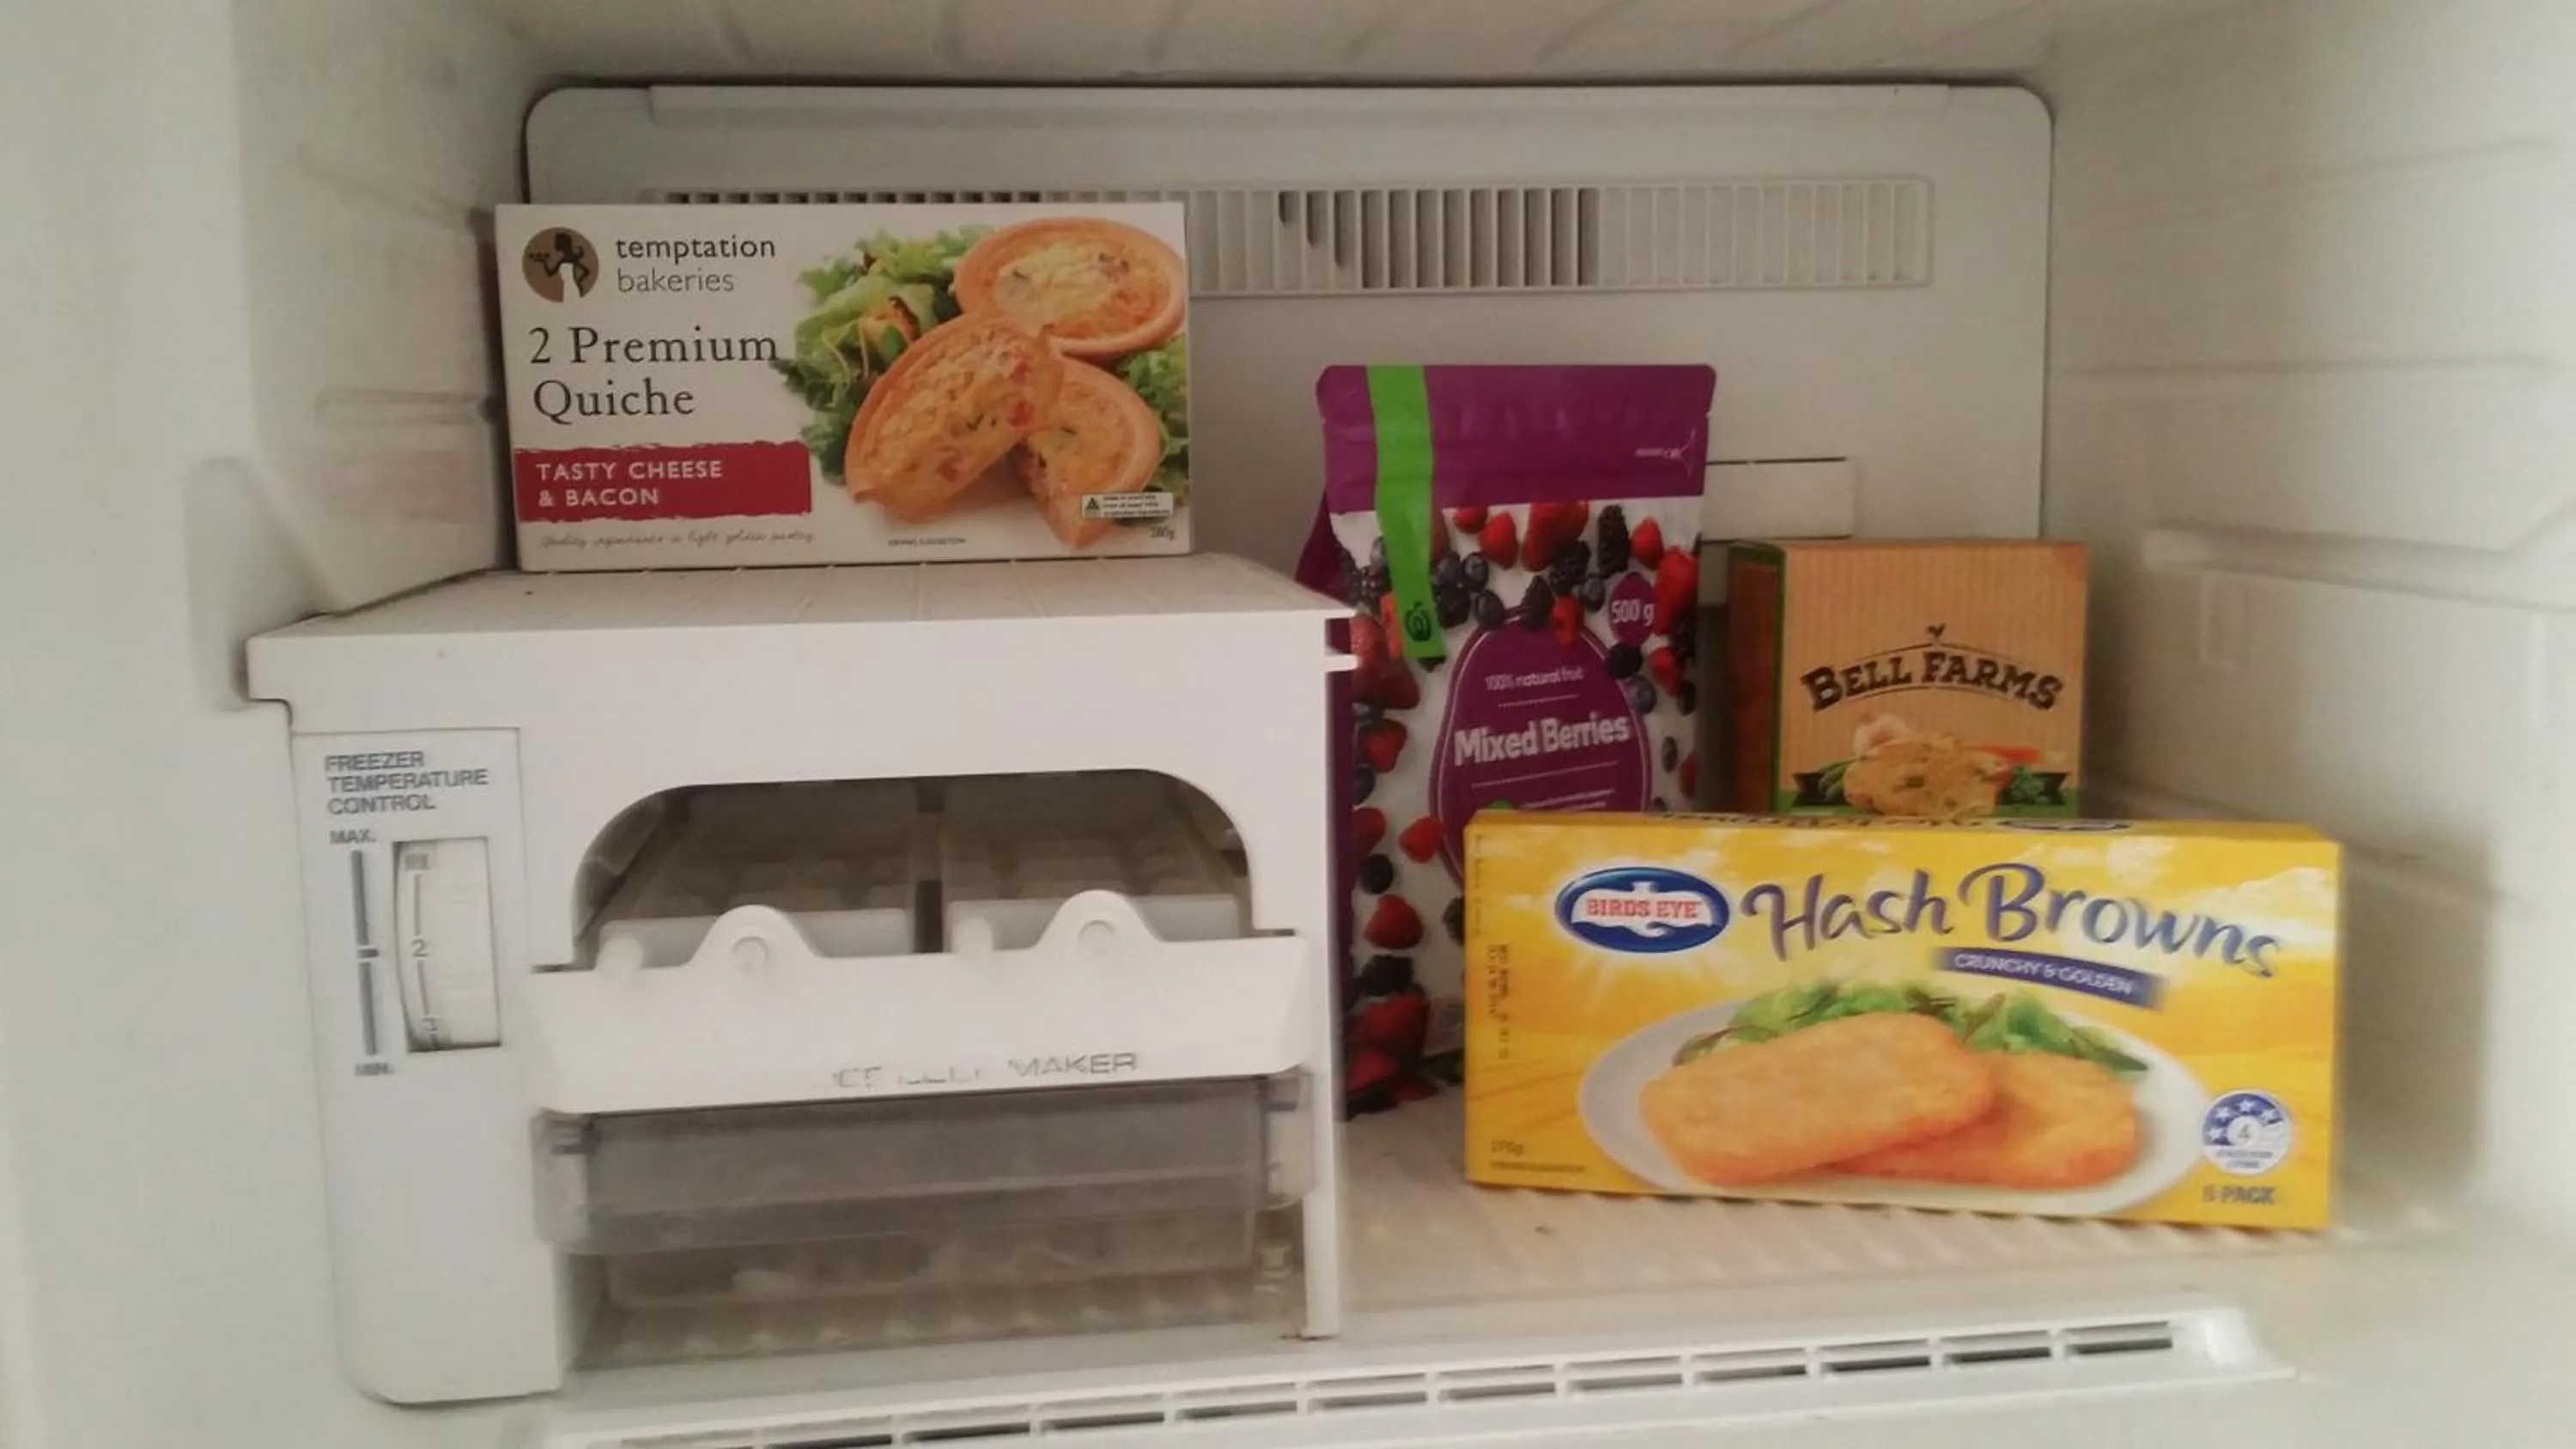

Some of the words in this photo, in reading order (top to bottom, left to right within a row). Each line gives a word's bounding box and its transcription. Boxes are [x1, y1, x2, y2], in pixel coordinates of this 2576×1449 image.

[616, 234, 775, 264] temptation
[617, 267, 735, 292] bakeries
[528, 327, 551, 364] 2
[568, 324, 780, 364] Premium
[532, 377, 696, 424] Quiche
[536, 461, 617, 482] TASTY
[629, 459, 722, 479] CHEESE
[538, 490, 554, 507] &
[565, 488, 659, 507] BACON
[1610, 601, 1640, 624] 500
[1641, 603, 1656, 626] g
[1800, 657, 1913, 712] BELL
[1919, 652, 2066, 711] FARMS
[1454, 721, 1540, 767] Mixed
[1540, 711, 1631, 753] Berries
[325, 750, 424, 772] FREEZER
[327, 768, 489, 793] TEMPERATURE
[327, 794, 437, 815] CONTROL
[1585, 897, 1650, 919] BIRDS
[1656, 900, 1703, 919] EYE
[1741, 868, 1955, 962] Hash
[1958, 863, 2281, 979] Browns
[410, 938, 429, 957] 2
[1954, 953, 2044, 977] CRUNCHY
[2057, 966, 2134, 996] GOLDEN
[1007, 1052, 1138, 1077] MAKER
[2237, 1124, 2254, 1139] 4
